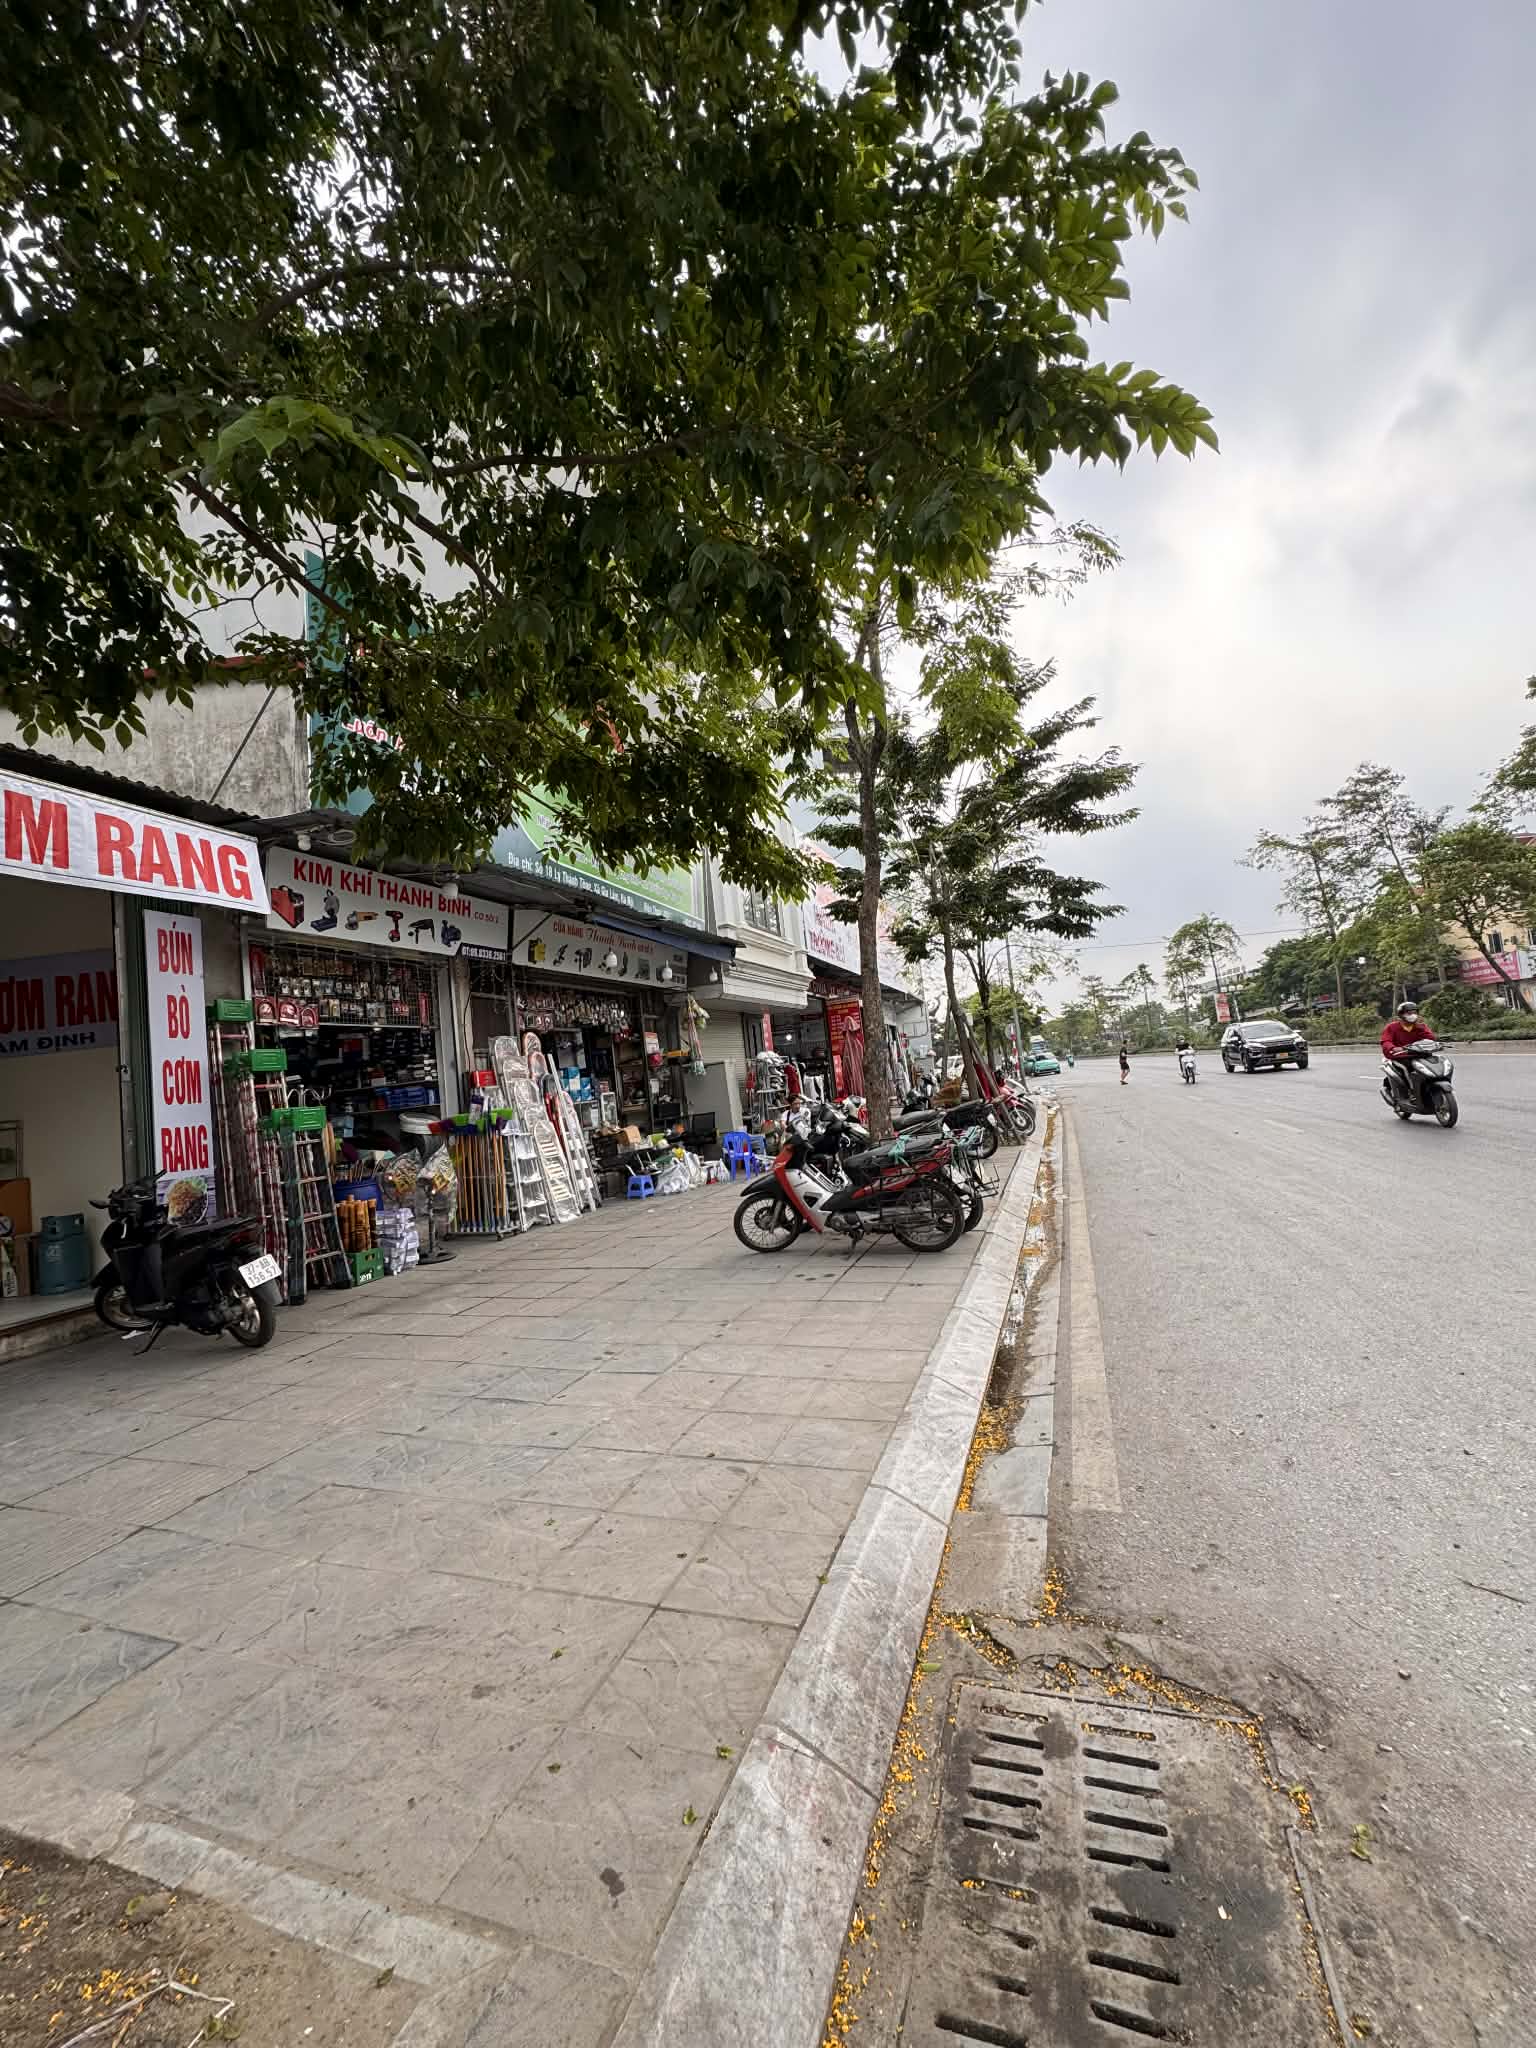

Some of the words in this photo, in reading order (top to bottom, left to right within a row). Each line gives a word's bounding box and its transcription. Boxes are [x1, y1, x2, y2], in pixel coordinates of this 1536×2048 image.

[3, 789, 70, 870] M
[94, 811, 254, 901] RANG
[293, 856, 333, 887] KIM
[340, 869, 373, 896] KHÍ
[377, 878, 433, 910] THANH
[157, 921, 193, 976] BÚN
[167, 984, 191, 1039] BÒ
[162, 1056, 203, 1105] CƠM
[160, 1124, 209, 1173] RANG
